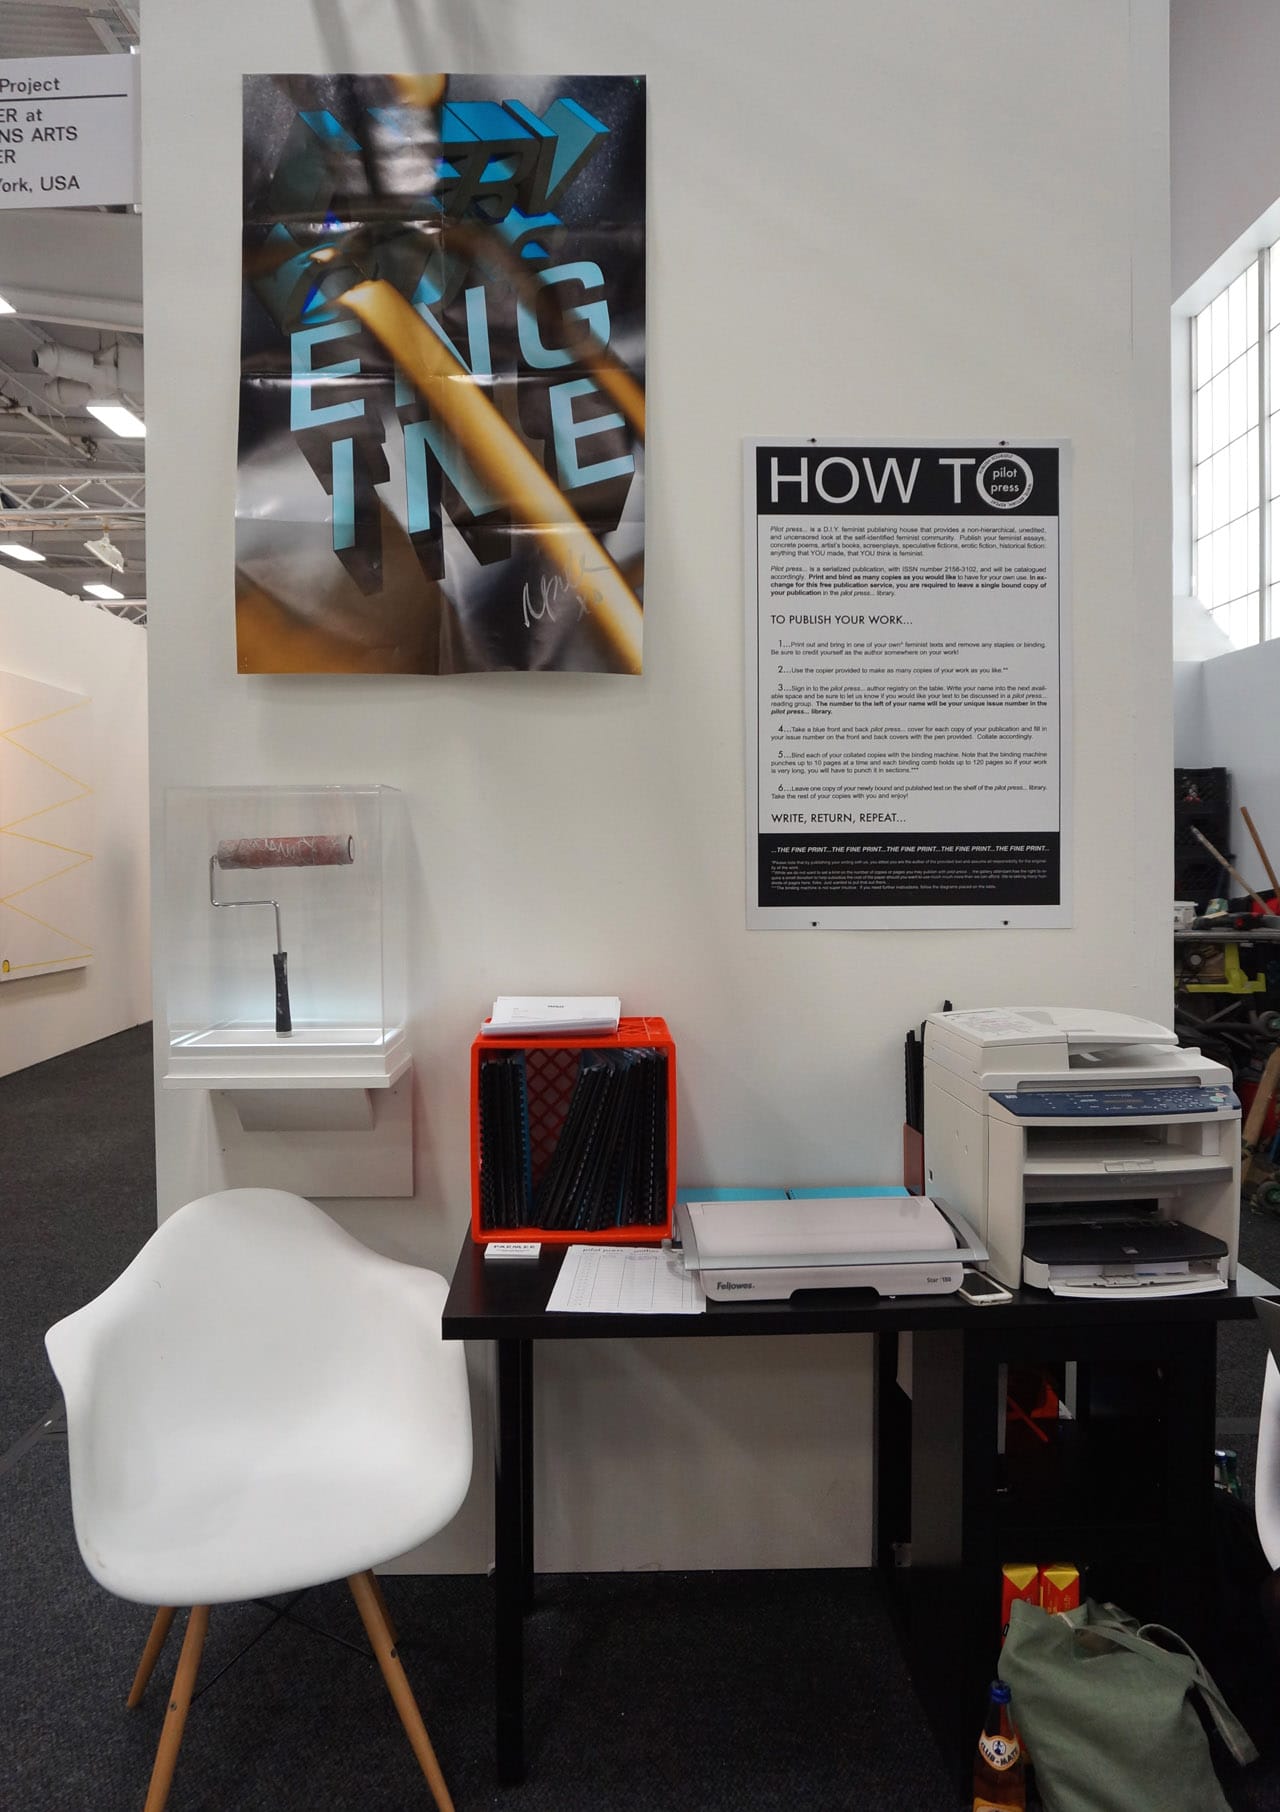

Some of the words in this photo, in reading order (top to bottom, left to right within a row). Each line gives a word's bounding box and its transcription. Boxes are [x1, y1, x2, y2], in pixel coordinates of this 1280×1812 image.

[0, 78, 60, 95] Project
[26, 109, 42, 122] at
[32, 126, 78, 142] ARTS
[41, 176, 80, 191] USA
[993, 466, 1017, 480] pilot
[770, 456, 921, 504] HOW
[939, 452, 1034, 510] TO
[990, 484, 1019, 495] press
[771, 615, 785, 625] TO
[789, 615, 832, 625] PUBLISH
[835, 615, 865, 625] YOUR
[771, 813, 807, 824] WRITE,
[811, 813, 856, 824] RETURN,
